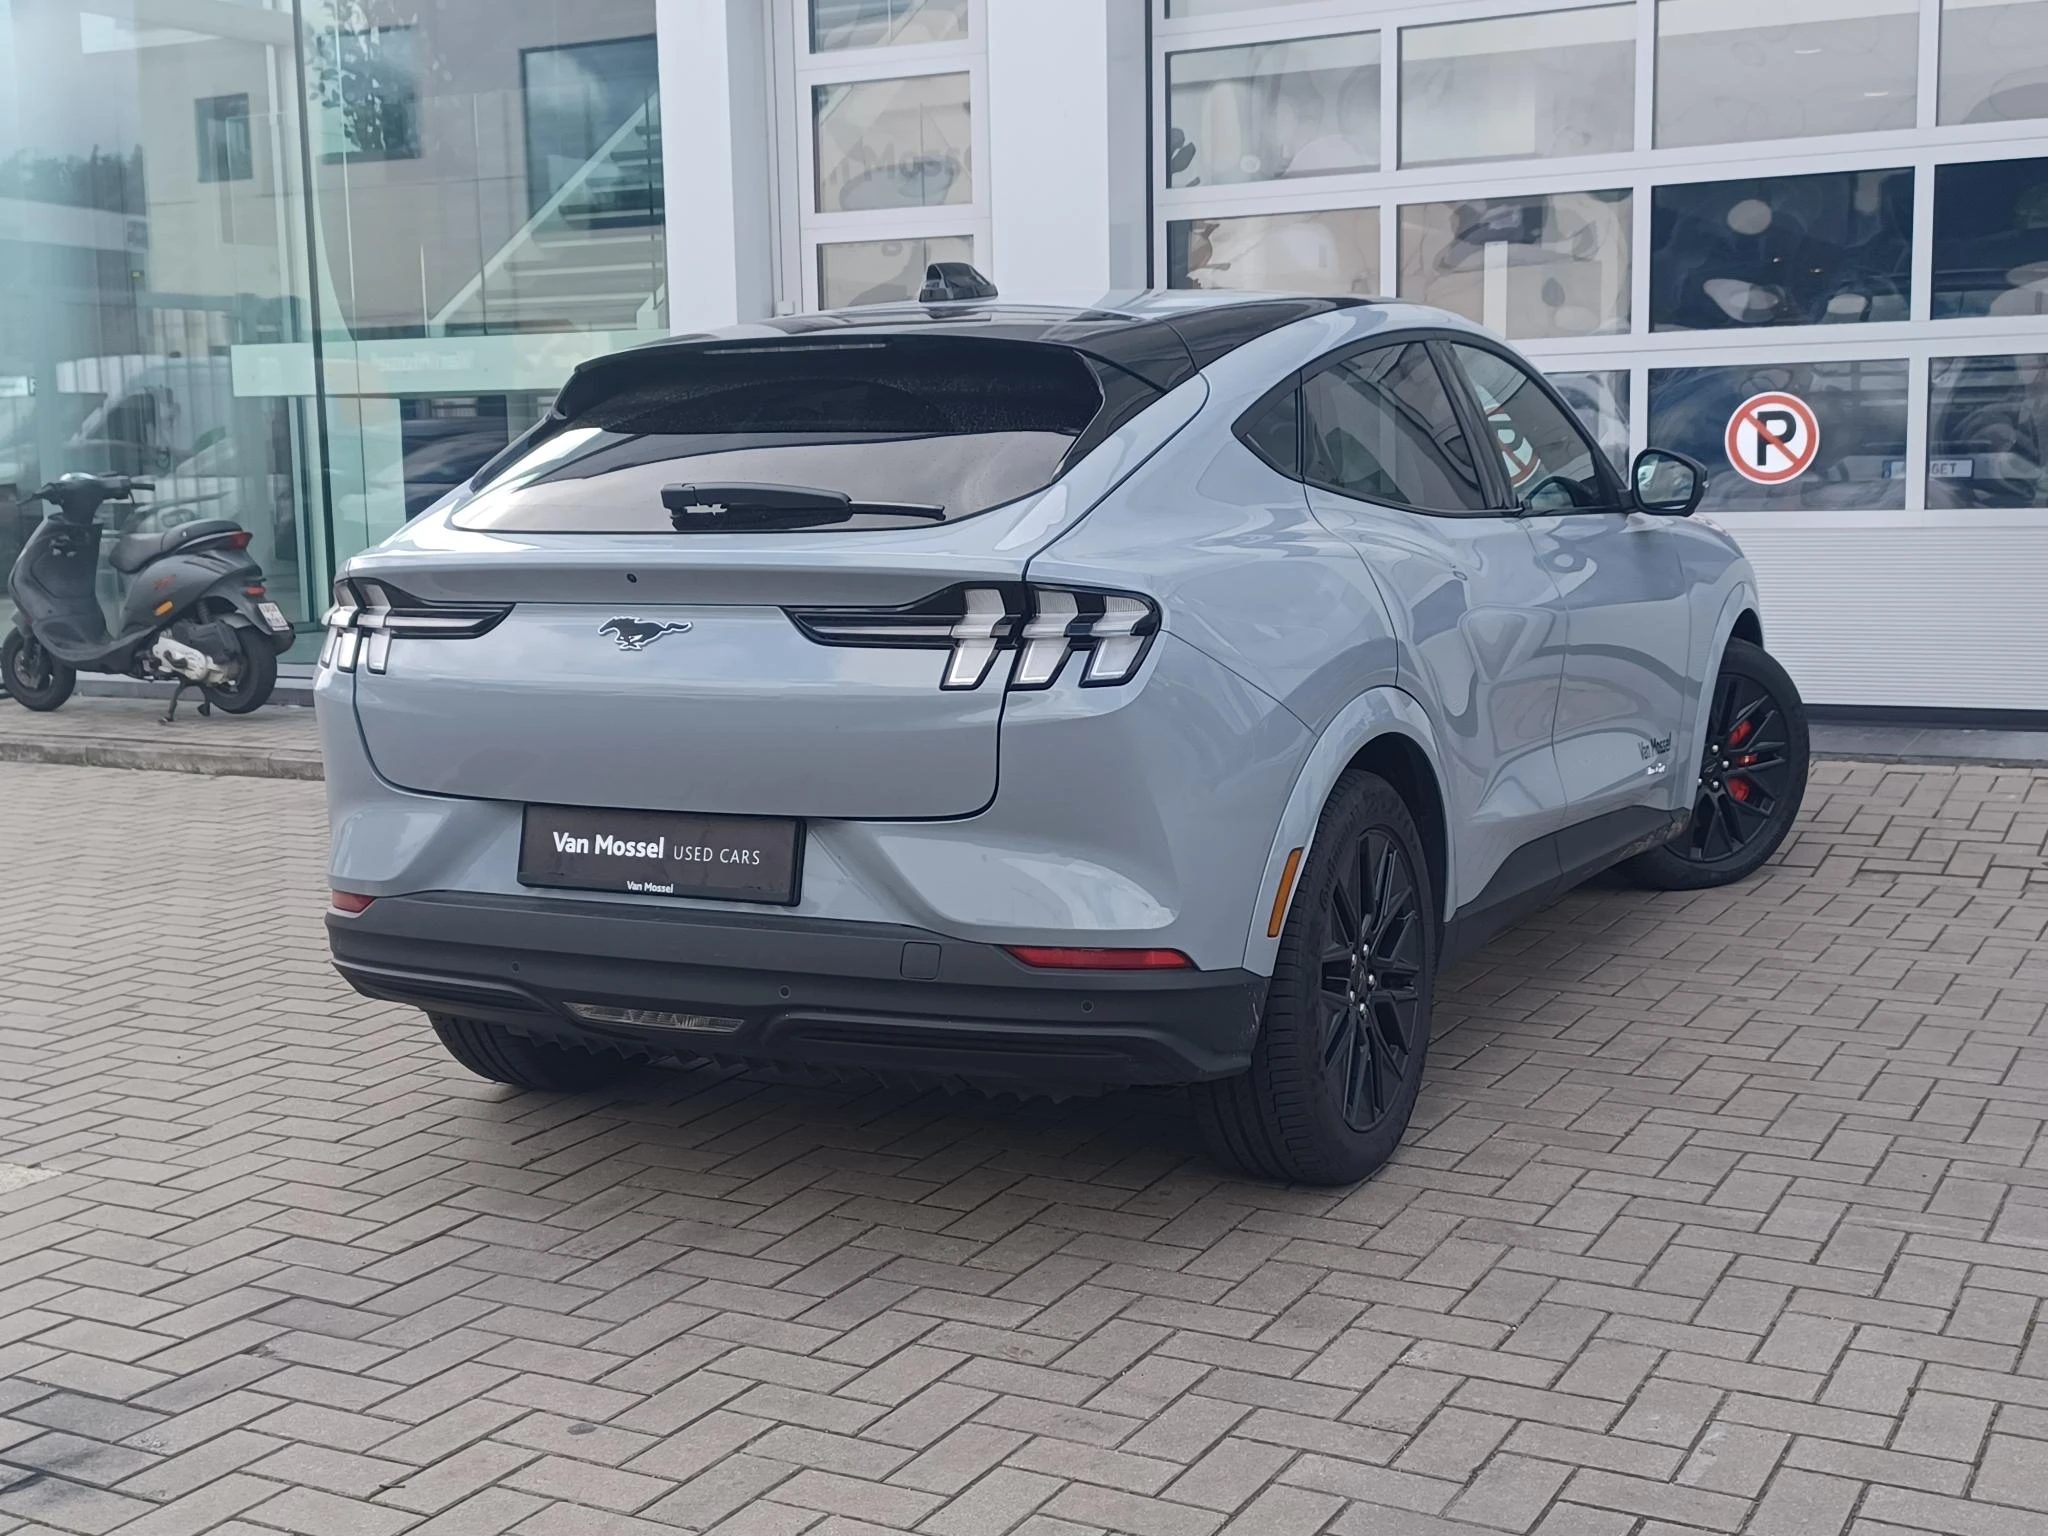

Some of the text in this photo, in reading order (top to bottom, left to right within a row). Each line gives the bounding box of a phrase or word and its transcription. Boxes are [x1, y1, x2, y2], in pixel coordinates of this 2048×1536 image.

[1757, 410, 1797, 466] P
[553, 831, 760, 865] Van Mossel USED CARS
[627, 880, 674, 894] Van Mossel
